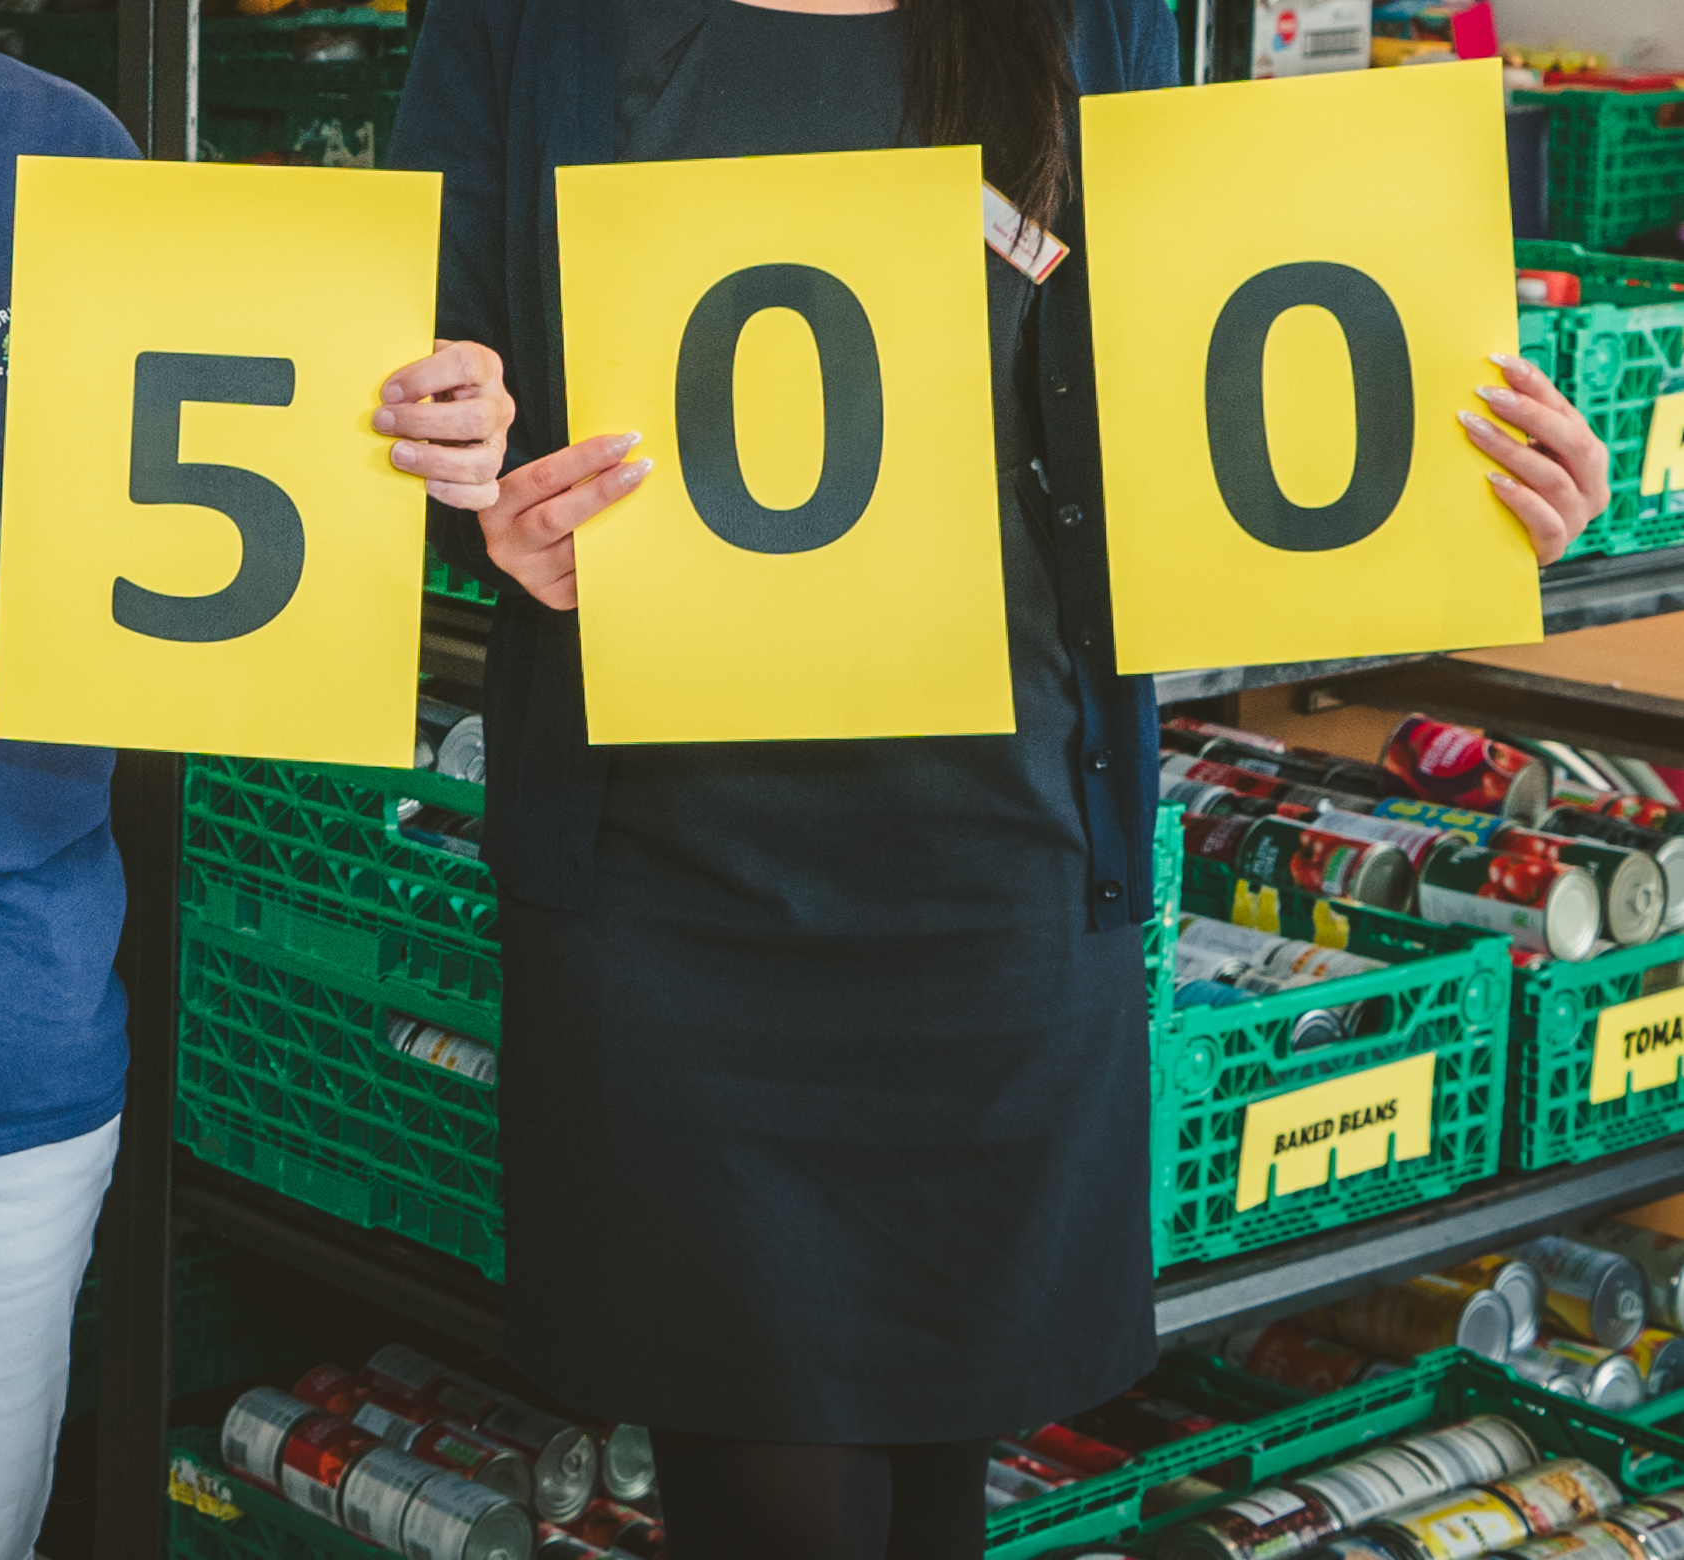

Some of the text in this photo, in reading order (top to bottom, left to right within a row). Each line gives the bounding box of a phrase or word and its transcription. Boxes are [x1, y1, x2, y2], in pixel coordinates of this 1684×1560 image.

[112, 350, 306, 643] 5
[674, 262, 885, 555] 0
[1204, 260, 1416, 552] 0
[1273, 1098, 1399, 1156] BAKED BEANS
